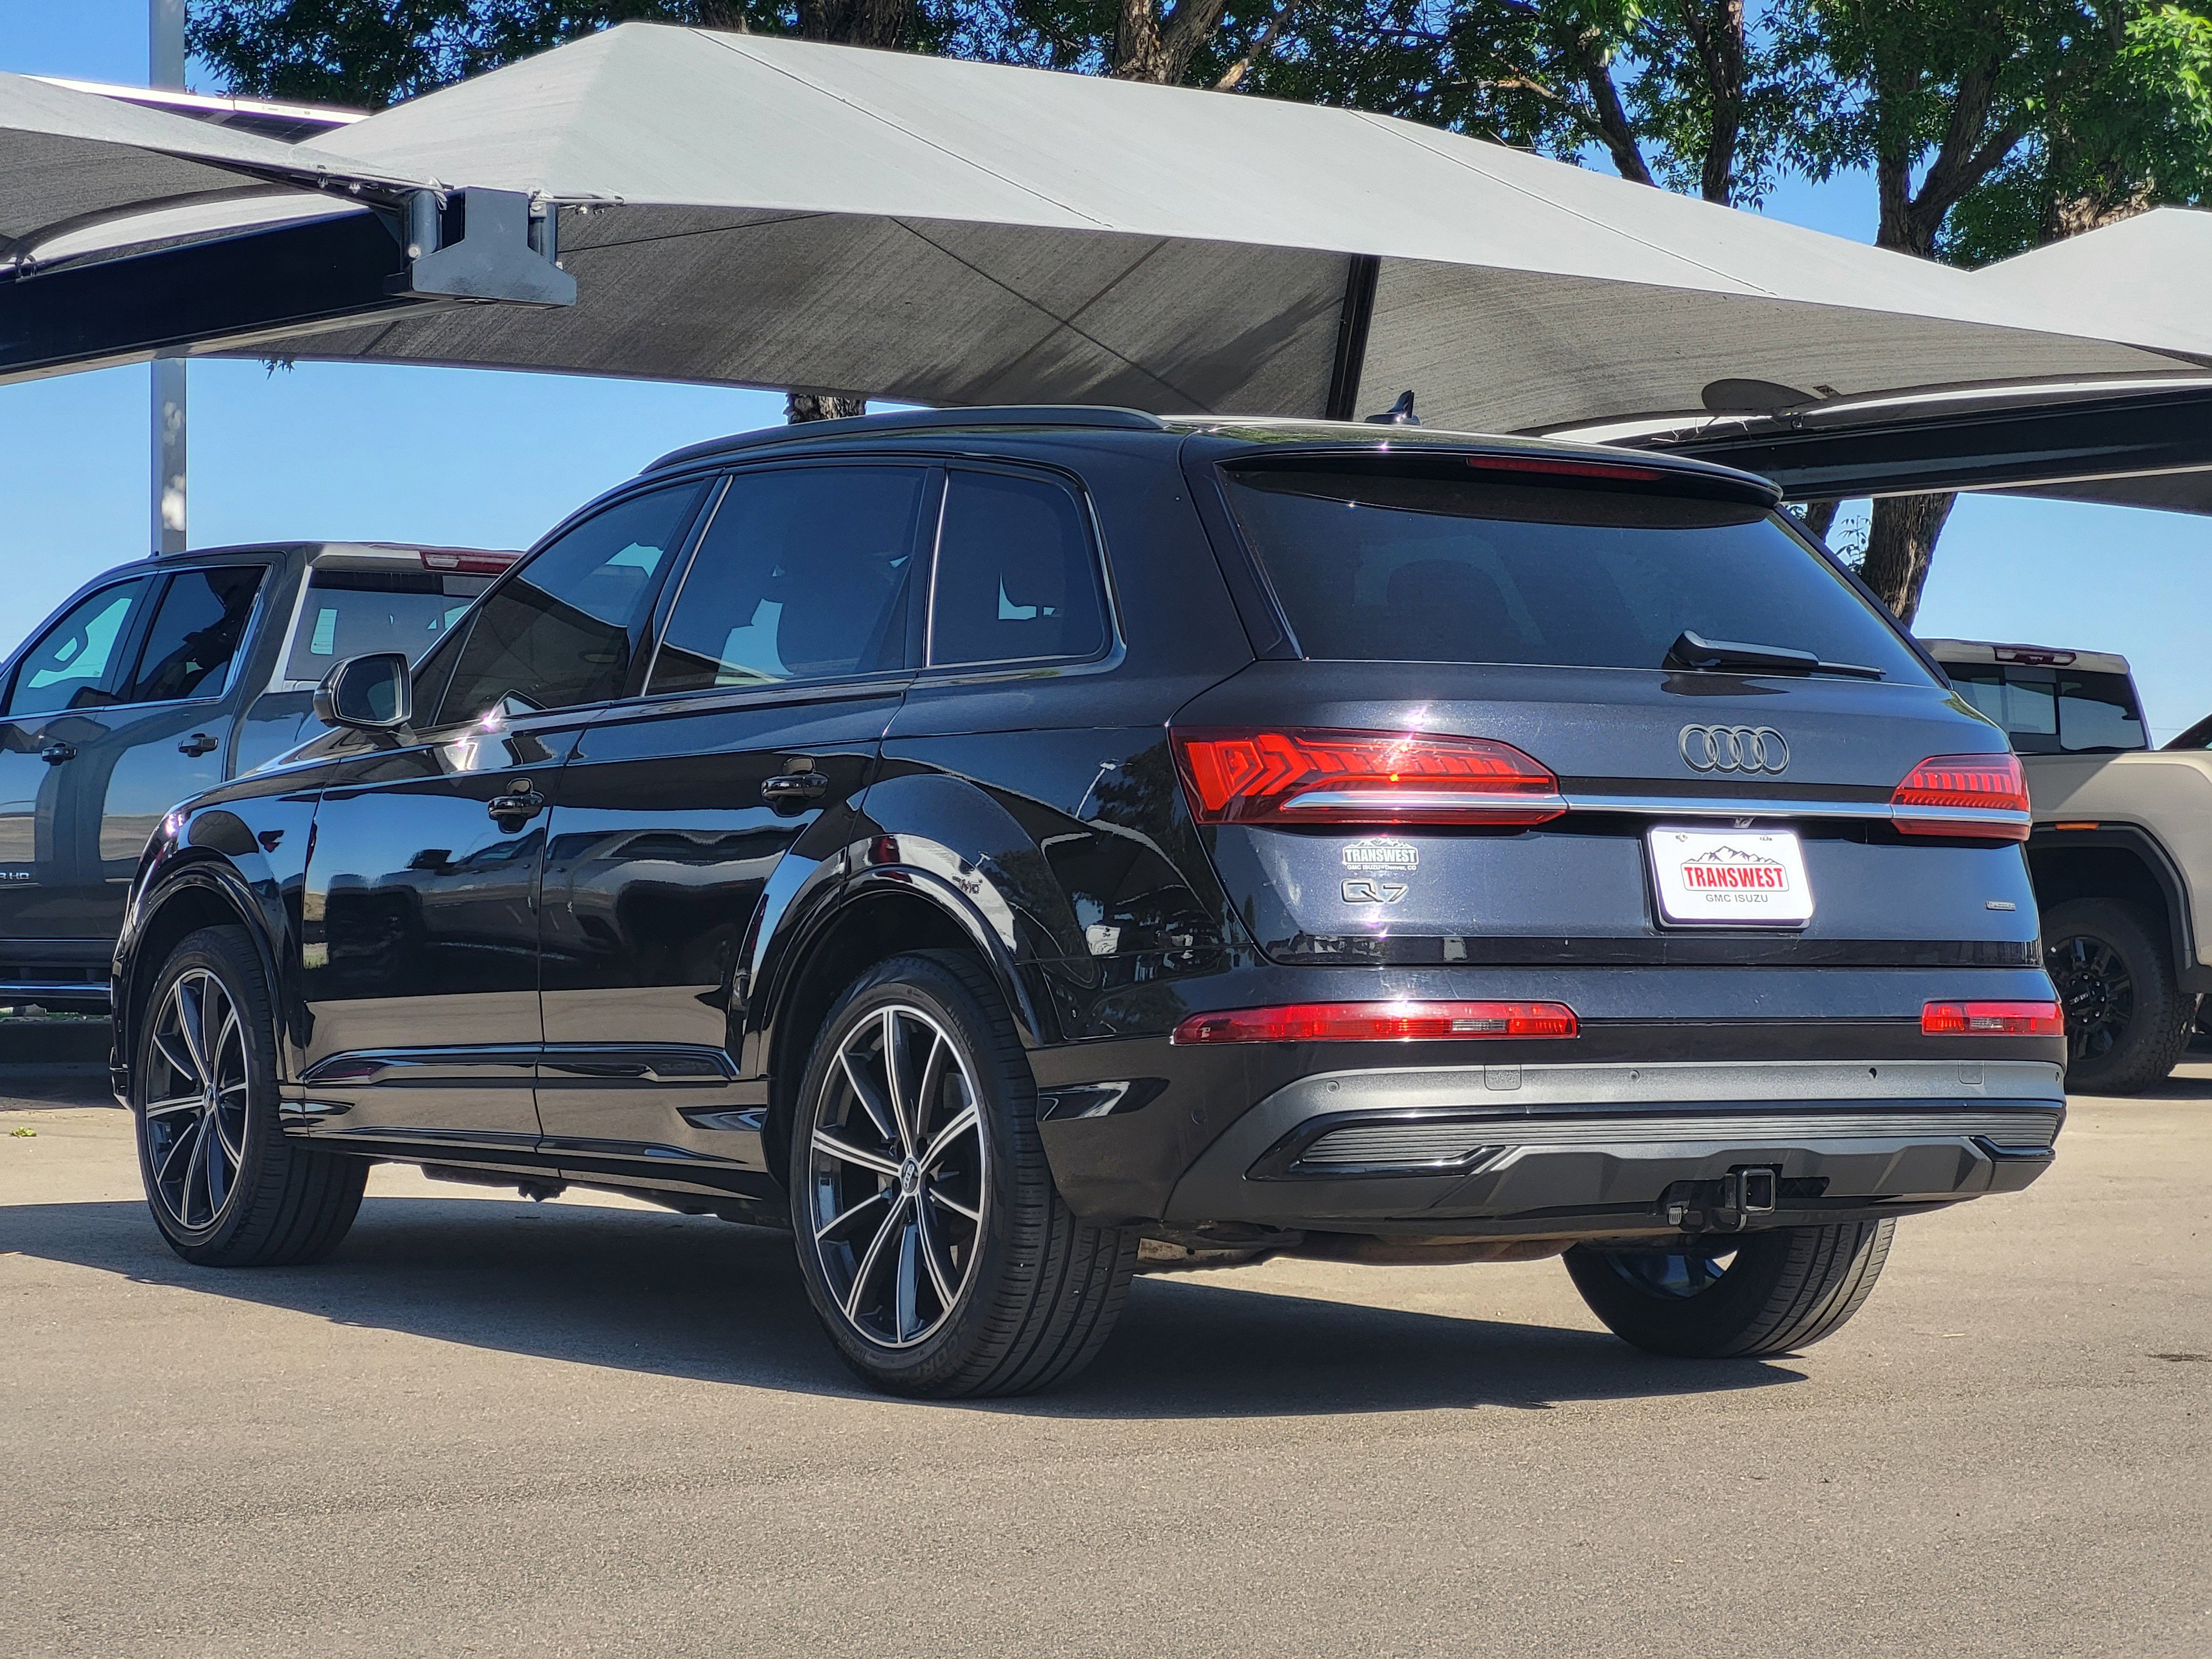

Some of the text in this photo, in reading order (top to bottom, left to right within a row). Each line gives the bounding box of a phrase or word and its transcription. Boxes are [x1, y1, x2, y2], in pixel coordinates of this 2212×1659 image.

[1345, 848, 1416, 862] TRANSWEST
[1684, 867, 1783, 888] TRANSWEST
[1341, 879, 1408, 903] Q7
[1705, 894, 1768, 902] GMC ISUZU
